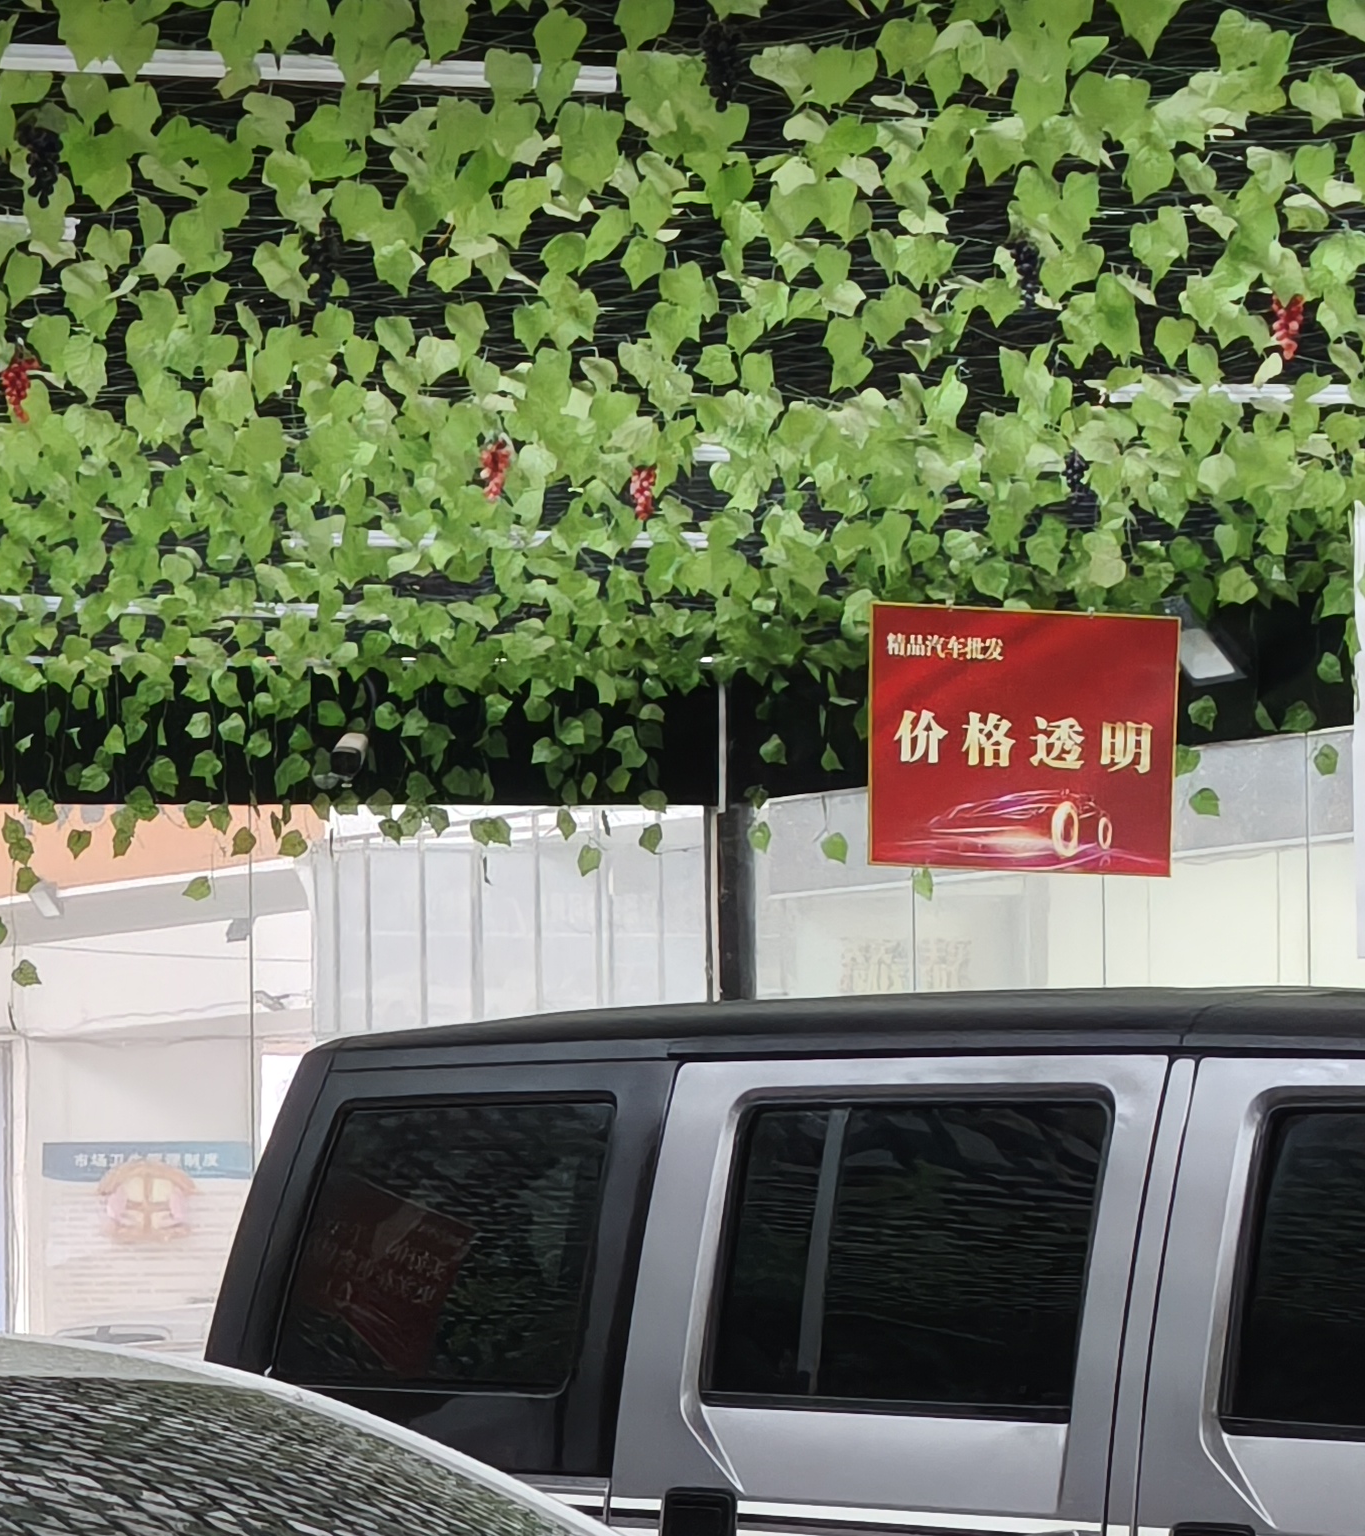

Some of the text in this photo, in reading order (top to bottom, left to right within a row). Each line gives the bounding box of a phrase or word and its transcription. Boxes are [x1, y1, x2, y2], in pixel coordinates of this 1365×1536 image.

[886, 632, 1004, 661] 精品汽车批发
[894, 709, 1153, 774] 价格透明
